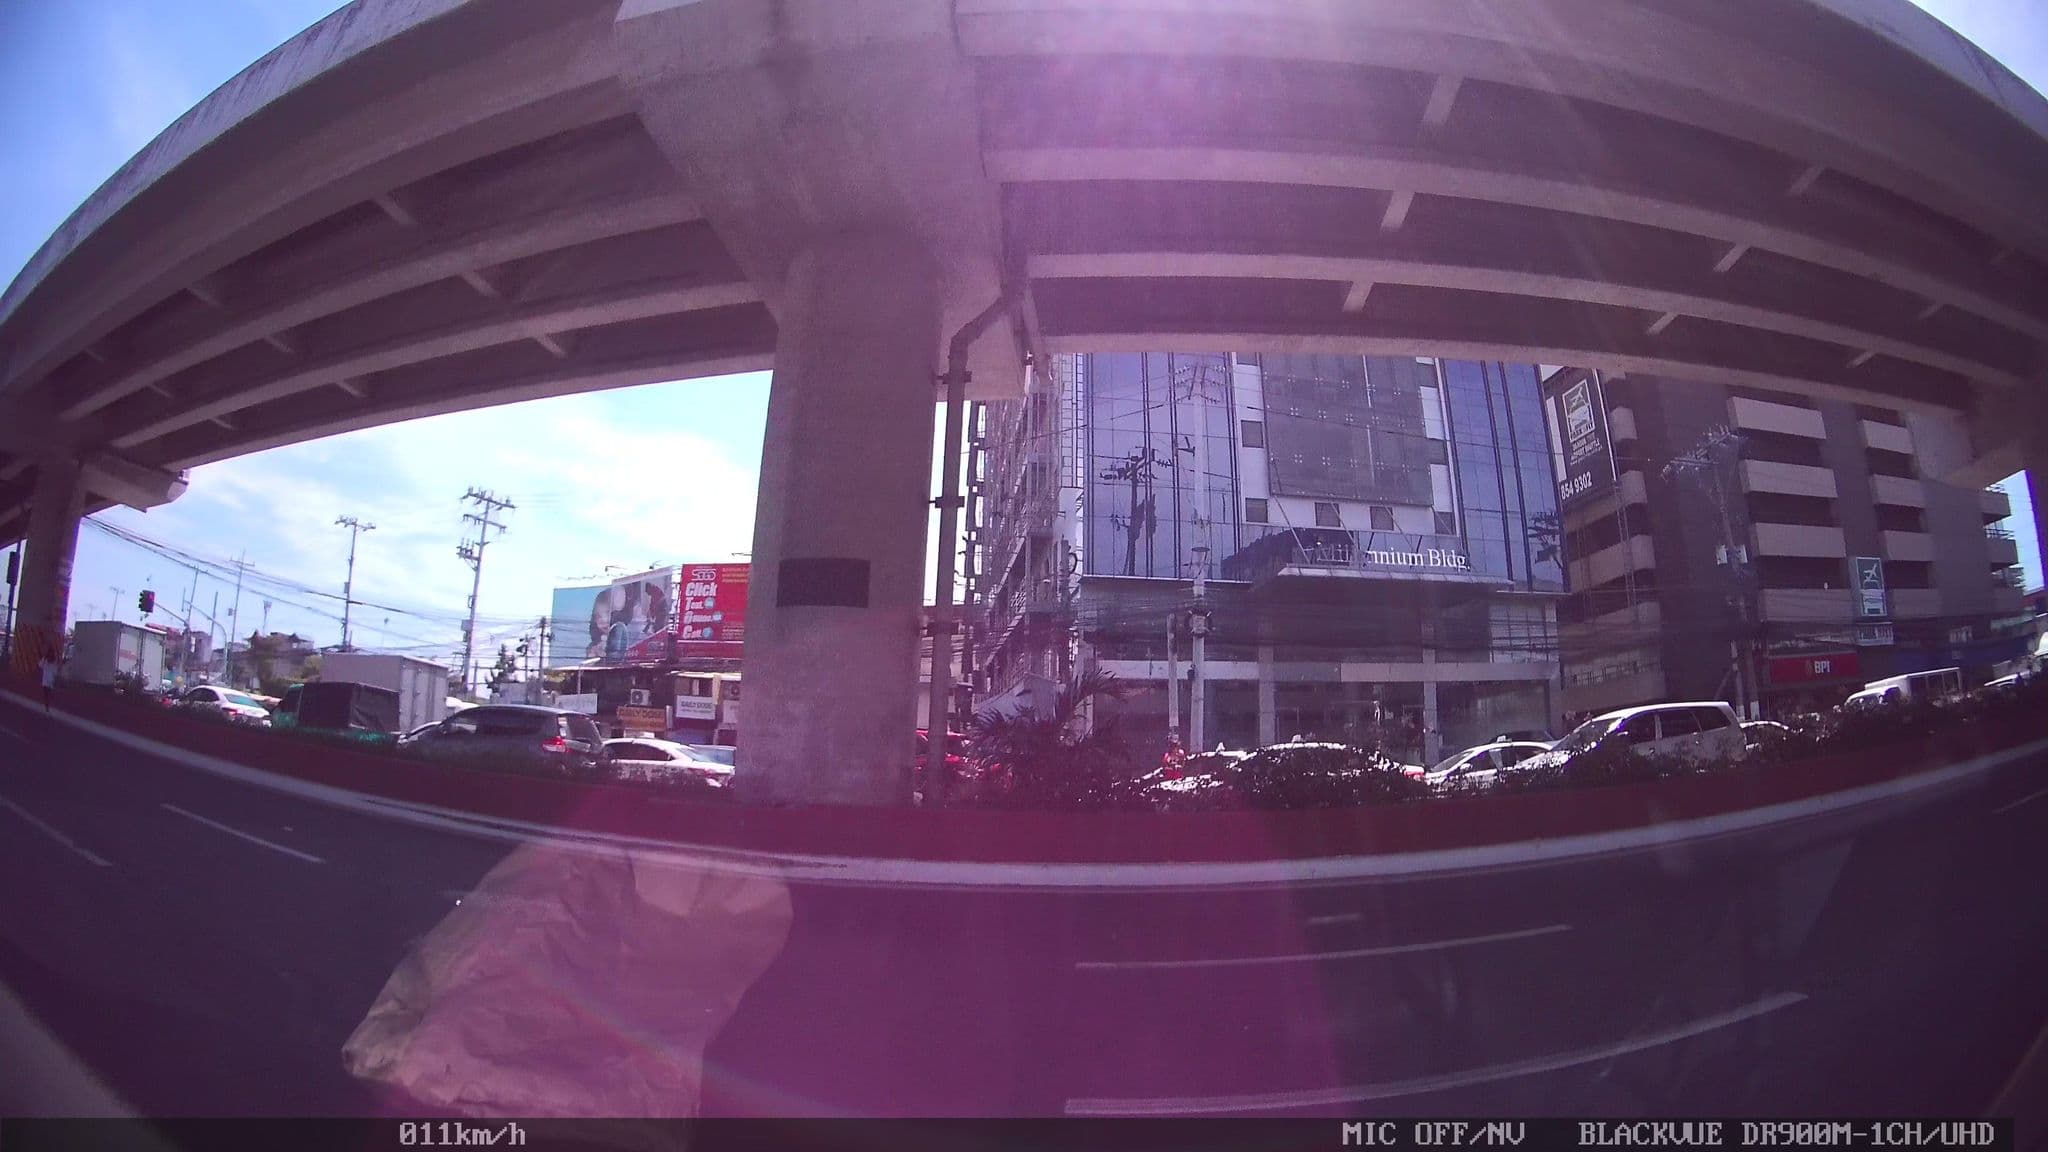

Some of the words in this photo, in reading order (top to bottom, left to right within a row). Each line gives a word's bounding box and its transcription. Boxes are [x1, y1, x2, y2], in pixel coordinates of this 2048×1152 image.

[1561, 481, 1574, 500] 854
[1574, 471, 1593, 493] 9302
[1428, 548, 1471, 571] Bldg.
[685, 582, 718, 597] Click
[1814, 661, 1830, 674] BPI
